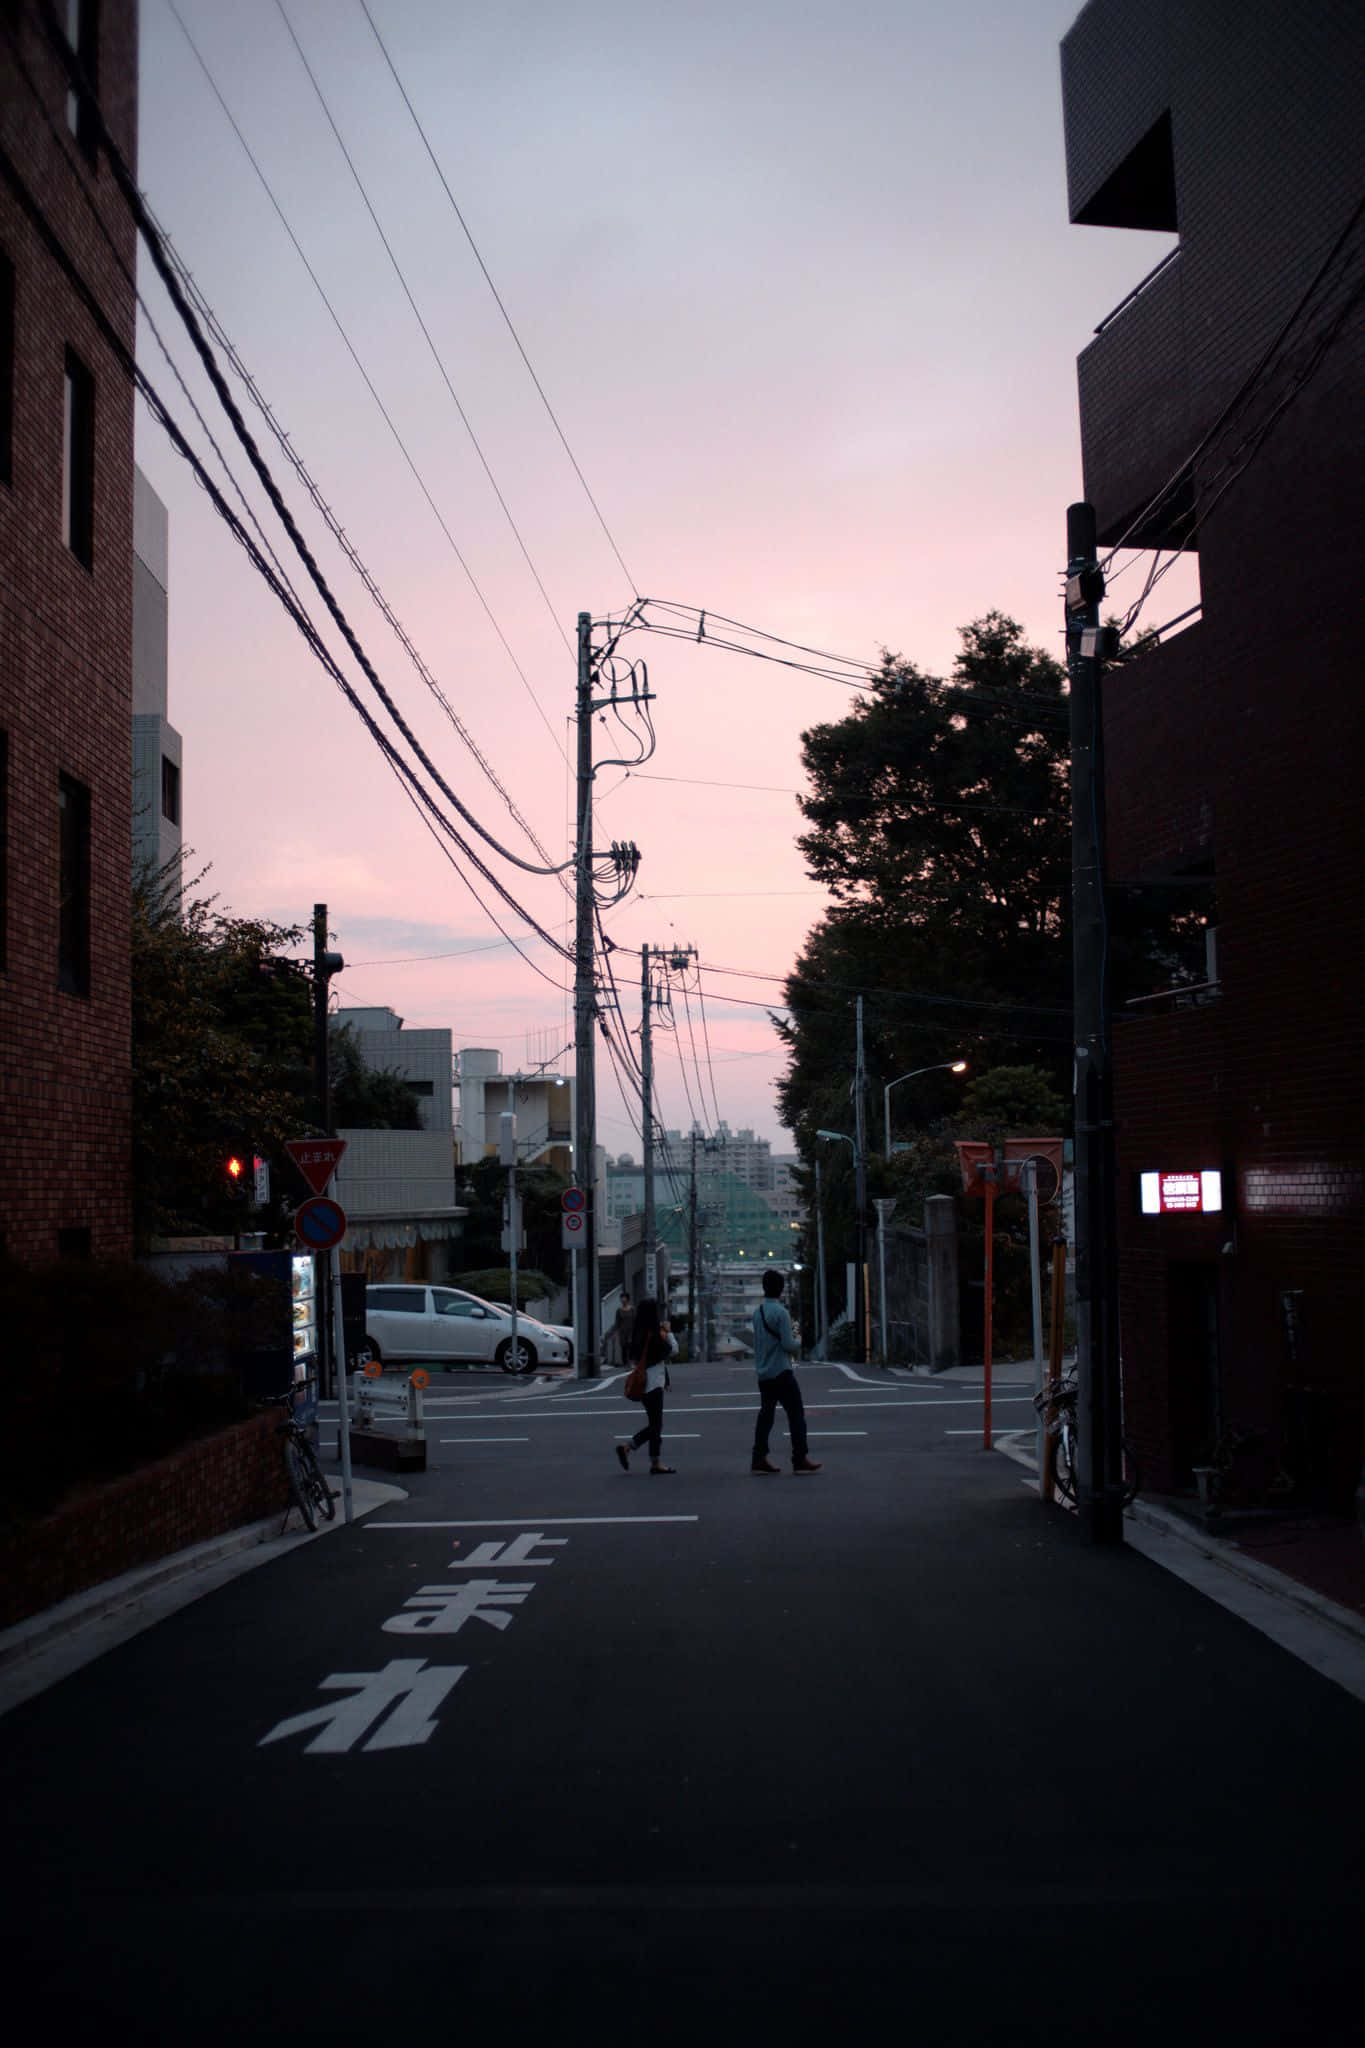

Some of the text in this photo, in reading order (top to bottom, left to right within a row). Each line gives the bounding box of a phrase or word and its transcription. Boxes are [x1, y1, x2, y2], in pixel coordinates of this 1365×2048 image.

[299, 1152, 336, 1165] 止まれ
[257, 1532, 569, 1753] 止まれ
